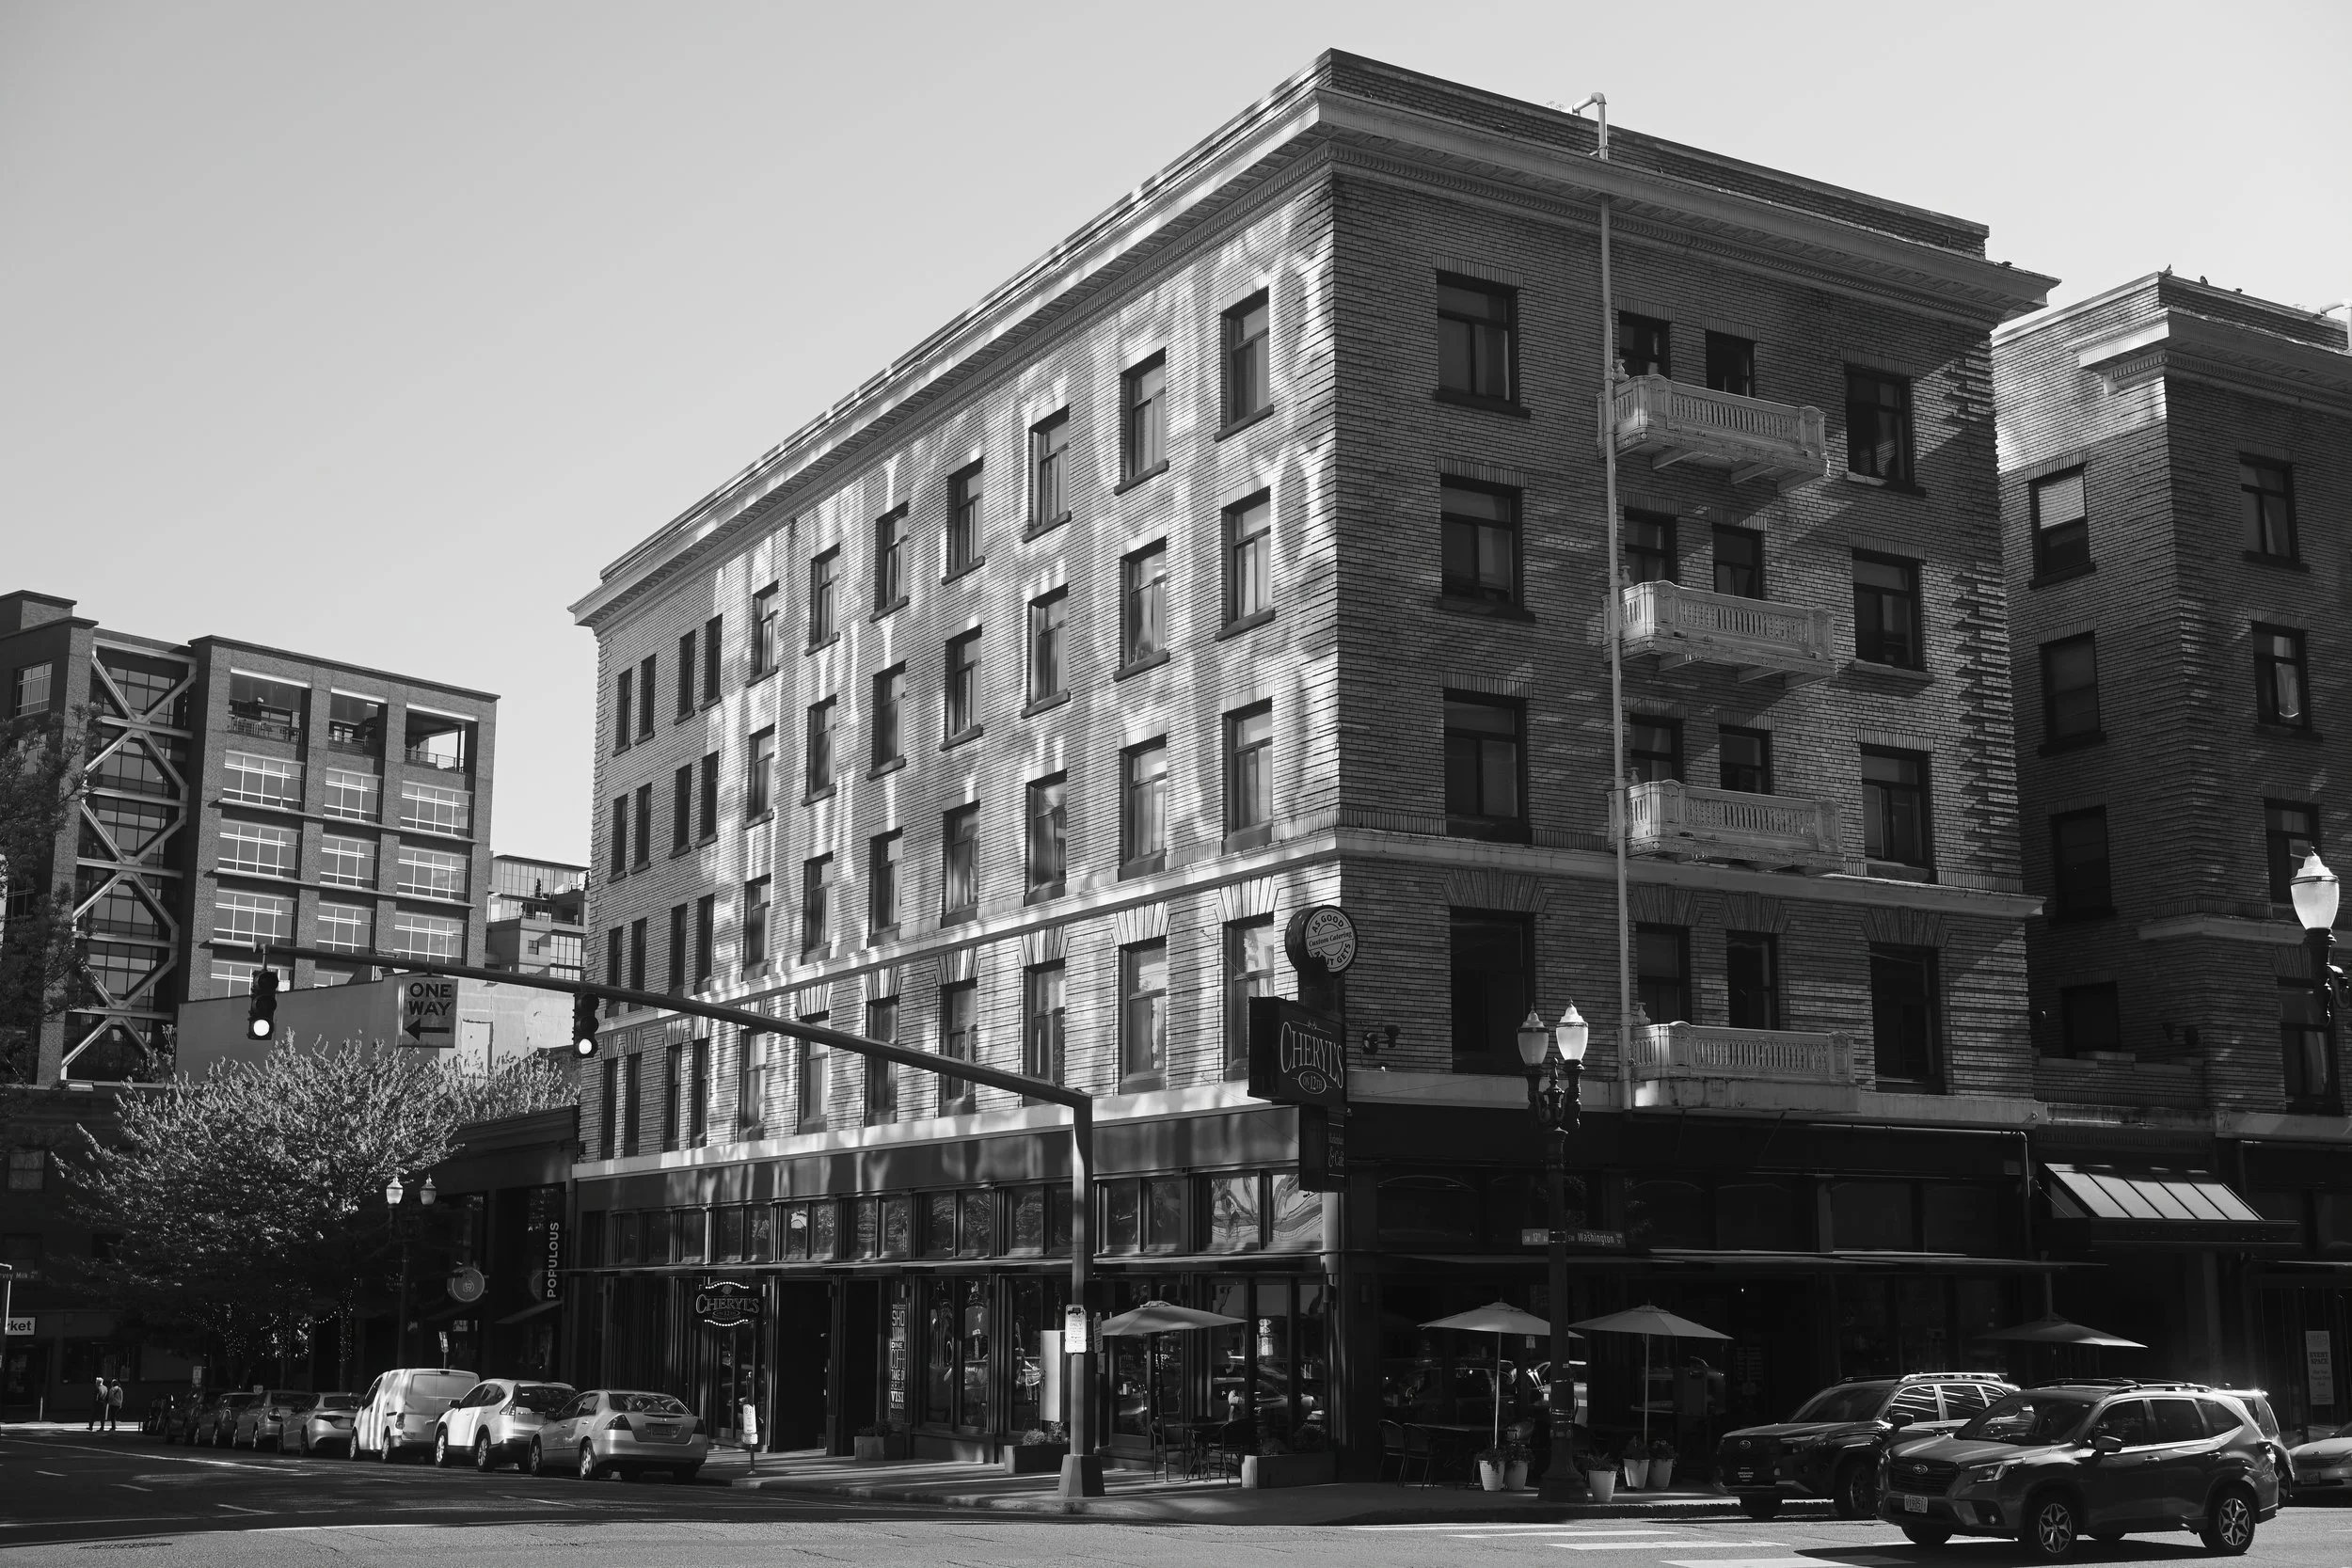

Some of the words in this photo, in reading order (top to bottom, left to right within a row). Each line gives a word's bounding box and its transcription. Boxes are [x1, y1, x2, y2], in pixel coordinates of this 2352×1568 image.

[1311, 920, 1321, 933] AS
[1321, 914, 1343, 927] GOOD
[1309, 939, 1329, 947] Custom
[1329, 931, 1353, 942] Catering
[1336, 943, 1351, 963] GETS
[409, 983, 452, 997] ONE
[408, 1001, 452, 1016] WAY
[1280, 1022, 1343, 1088] CHERYL'S
[1577, 1232, 1614, 1245] Washington
[547, 1222, 560, 1298] POPULOUS
